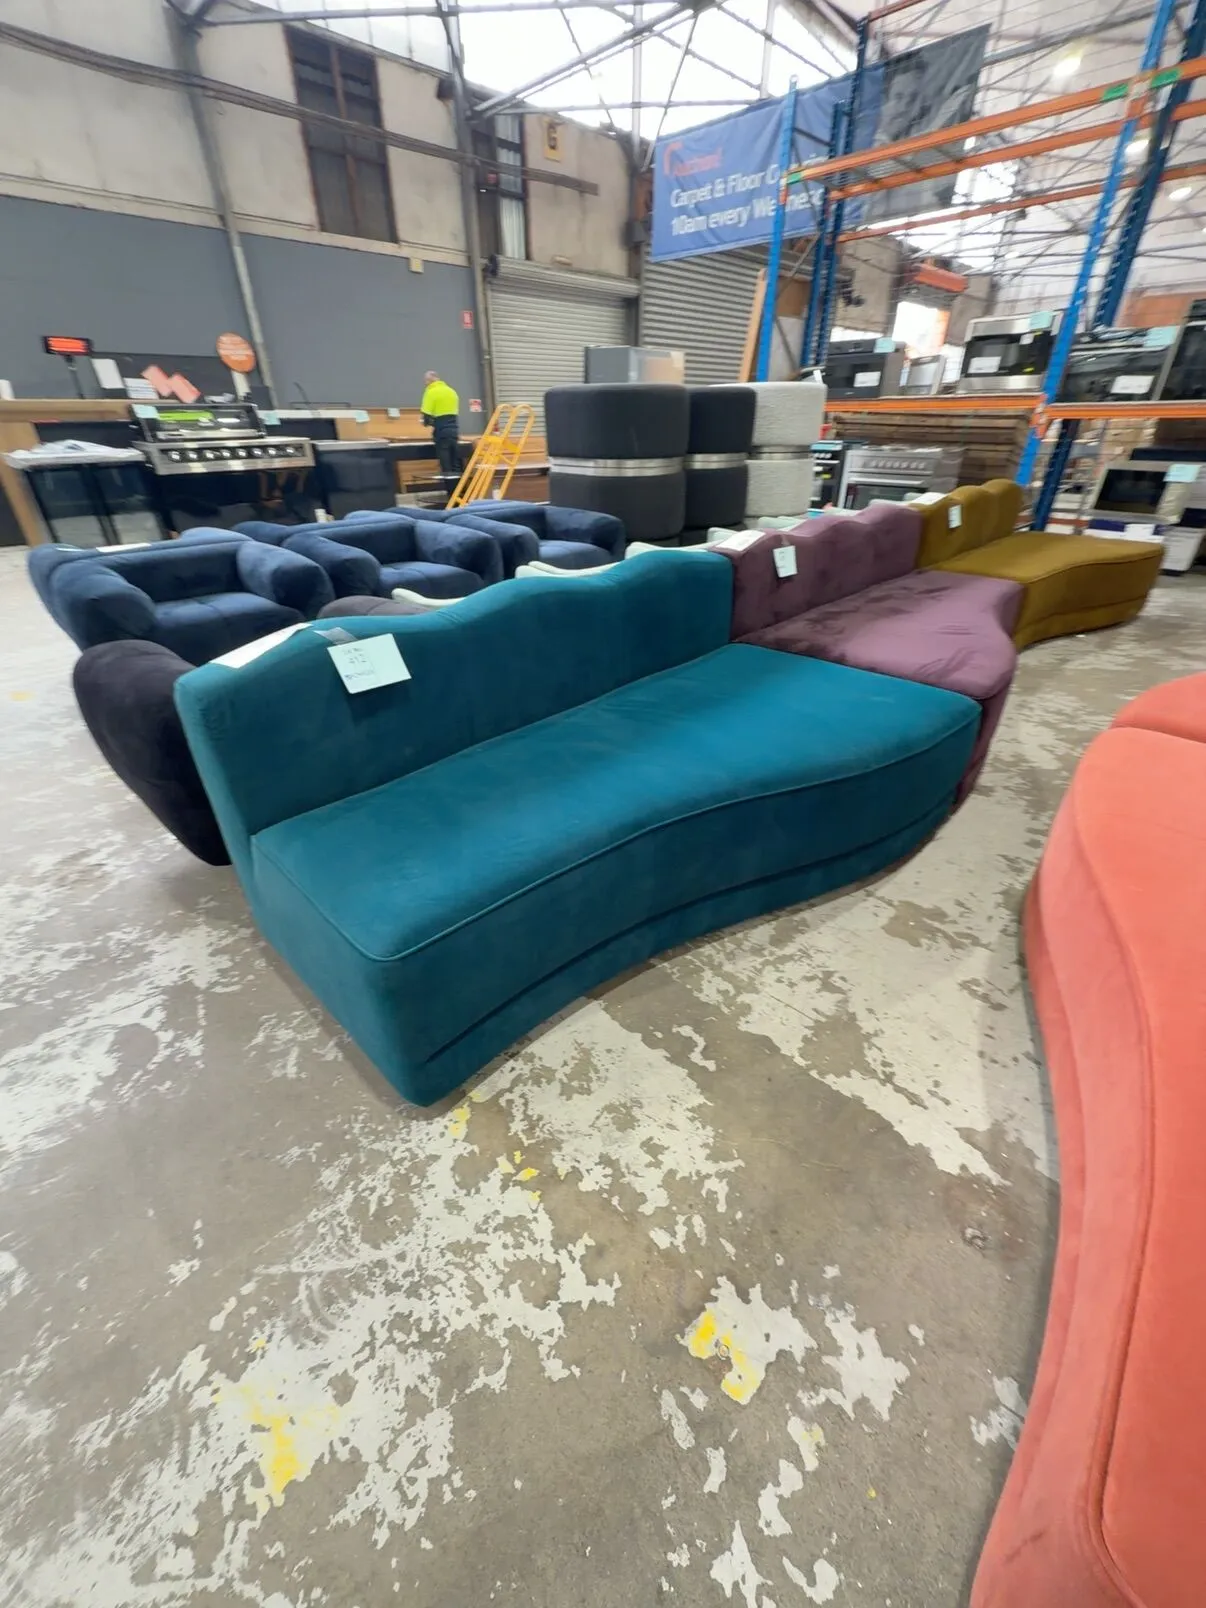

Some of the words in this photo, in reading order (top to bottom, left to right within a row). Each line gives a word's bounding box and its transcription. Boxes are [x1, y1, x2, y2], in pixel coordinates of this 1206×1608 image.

[670, 184, 713, 209] Carpet
[713, 178, 726, 199] &
[727, 171, 766, 195] Floor
[708, 204, 751, 228] every
